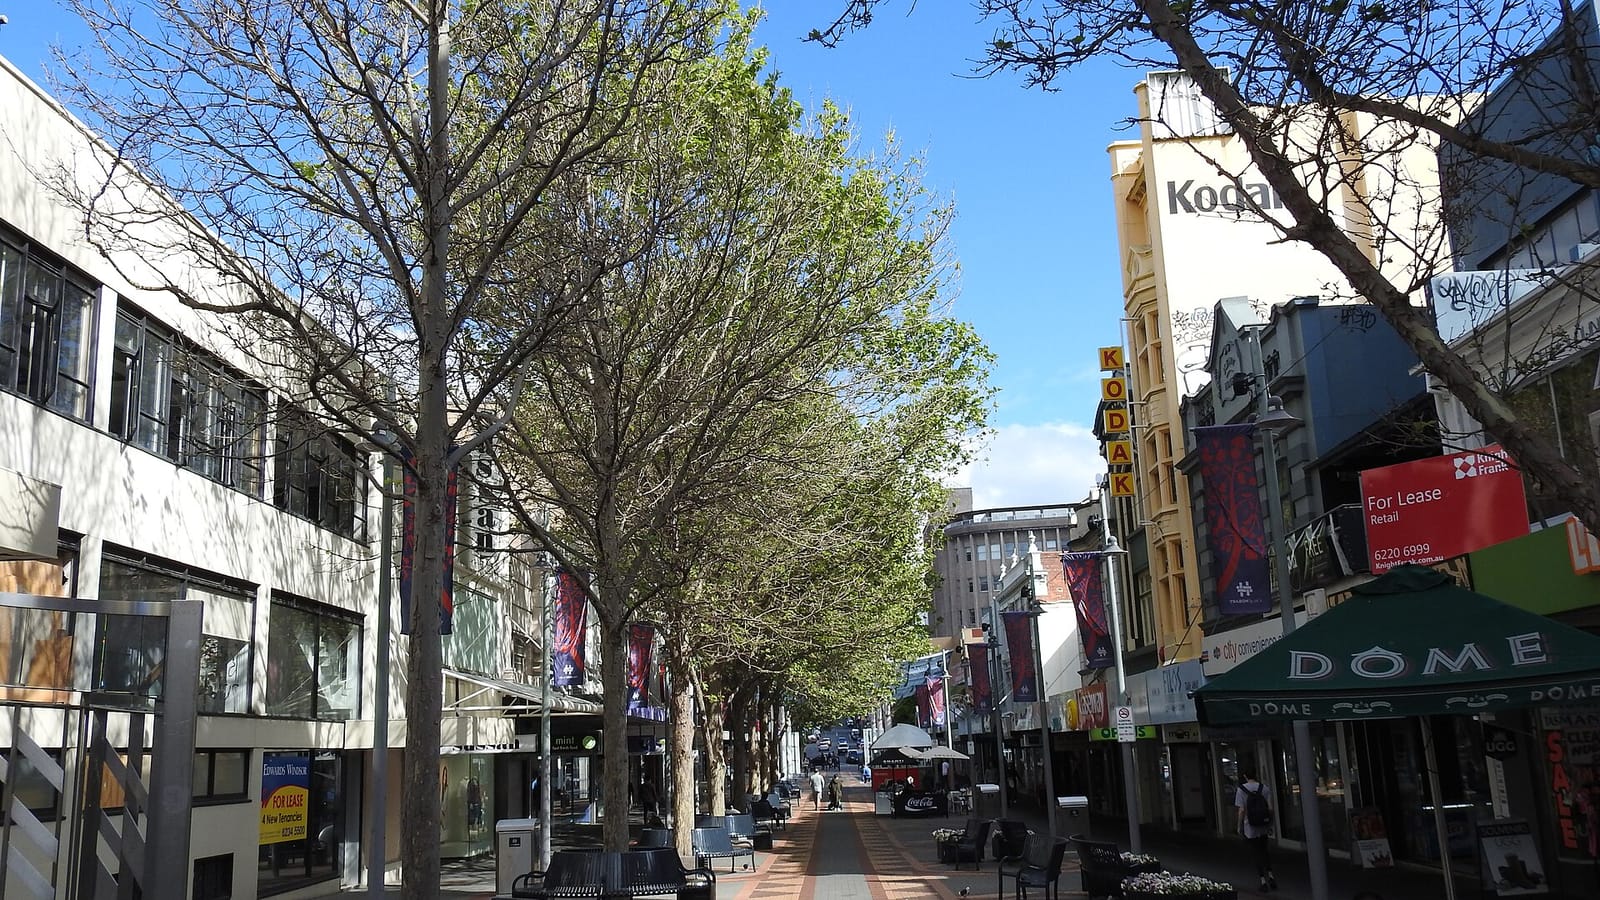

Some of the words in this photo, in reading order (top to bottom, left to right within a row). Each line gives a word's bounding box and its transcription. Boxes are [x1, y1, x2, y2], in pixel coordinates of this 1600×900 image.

[1103, 350, 1132, 493] KODAK
[1477, 449, 1509, 464] Knigh
[1478, 463, 1509, 476] Frank
[1368, 496, 1393, 511] For
[1398, 488, 1442, 506] Lease
[1370, 511, 1399, 525] Retail
[1374, 547, 1400, 561] 6220
[1403, 543, 1430, 556] 6999
[1223, 640, 1236, 663] city
[1486, 742, 1516, 753] UGG
[263, 764, 285, 776] EDWARDS
[287, 764, 307, 776] WINDSOR
[273, 795, 285, 809] FOR
[286, 794, 304, 808] LEASE
[266, 815, 278, 824] New
[278, 812, 302, 823] Tenancies
